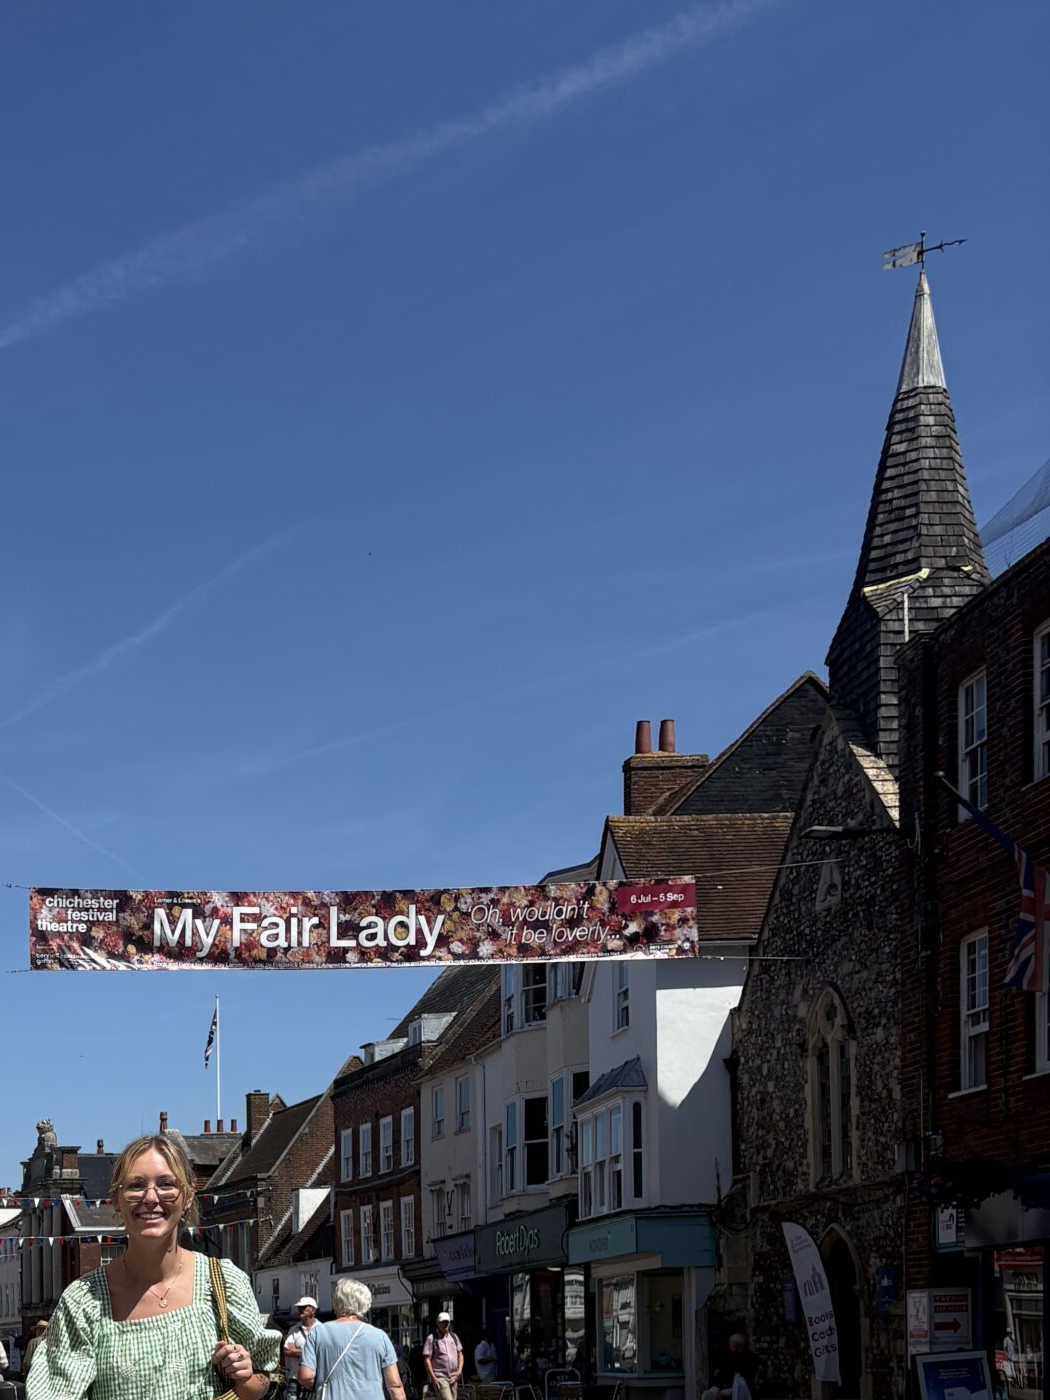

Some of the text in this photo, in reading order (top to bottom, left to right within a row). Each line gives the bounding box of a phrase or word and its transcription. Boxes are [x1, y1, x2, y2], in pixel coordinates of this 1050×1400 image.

[45, 895, 119, 908] chichester
[630, 894, 637, 904] 6
[638, 894, 652, 904] Jul
[659, 893, 665, 902] 5
[666, 892, 685, 904] Sep
[67, 909, 117, 922] festival
[36, 918, 87, 932] theatre
[153, 904, 445, 958] My Fair Lady
[506, 927, 517, 945] it
[521, 925, 547, 945] be
